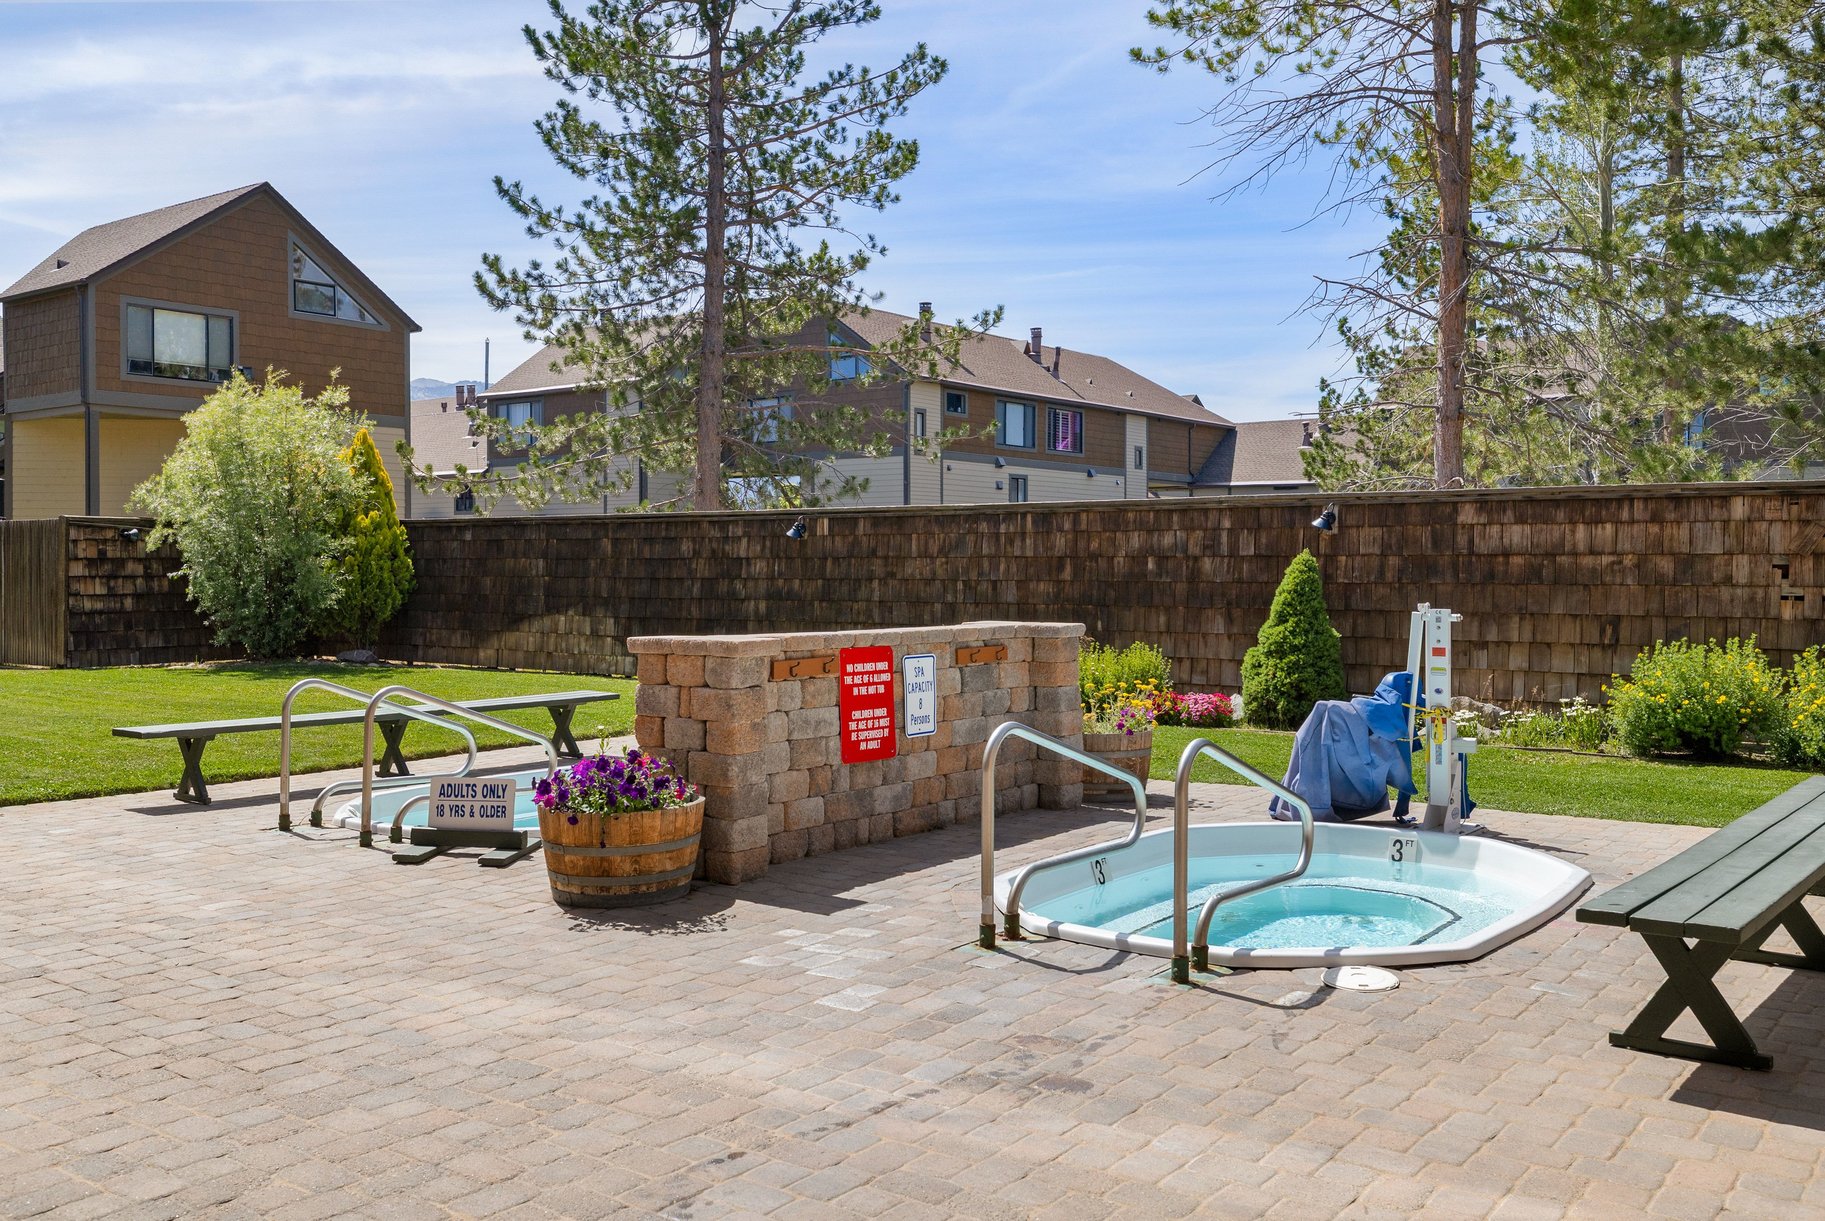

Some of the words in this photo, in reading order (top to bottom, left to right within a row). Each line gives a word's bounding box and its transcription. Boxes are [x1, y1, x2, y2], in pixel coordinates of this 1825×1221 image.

[846, 664, 853, 672] NO
[854, 662, 875, 672] CHILDREN
[876, 662, 888, 670] UNDER
[914, 666, 925, 678] SPA
[844, 676, 853, 684] THE
[854, 675, 862, 684] AGE
[863, 674, 869, 683] OF
[870, 674, 873, 682] 6
[873, 673, 891, 682] ALLOWED
[853, 687, 858, 696] IN
[859, 686, 867, 695] THE
[868, 685, 876, 694] HOT
[908, 681, 933, 694] CAPACITY
[919, 698, 923, 710] 8
[852, 709, 873, 719] CHILDREN
[874, 708, 887, 717] UNDER
[911, 714, 930, 725] Persons
[849, 721, 857, 730] THE
[858, 720, 867, 729] AGE
[868, 720, 873, 728] OF
[874, 719, 879, 728] 16
[880, 718, 890, 727] MUST
[851, 732, 857, 741] BE
[858, 729, 883, 740] SUPERVISED
[884, 728, 889, 737] BY
[860, 741, 866, 750] AN
[867, 740, 880, 749] ADULT
[439, 783, 477, 798] ADULTS
[482, 784, 508, 799] ONLY
[436, 804, 445, 817] 18
[449, 804, 465, 818] YRS
[469, 804, 475, 818] &
[479, 805, 506, 818] OLDER
[1392, 839, 1403, 862] 3
[1095, 860, 1105, 885] 3
